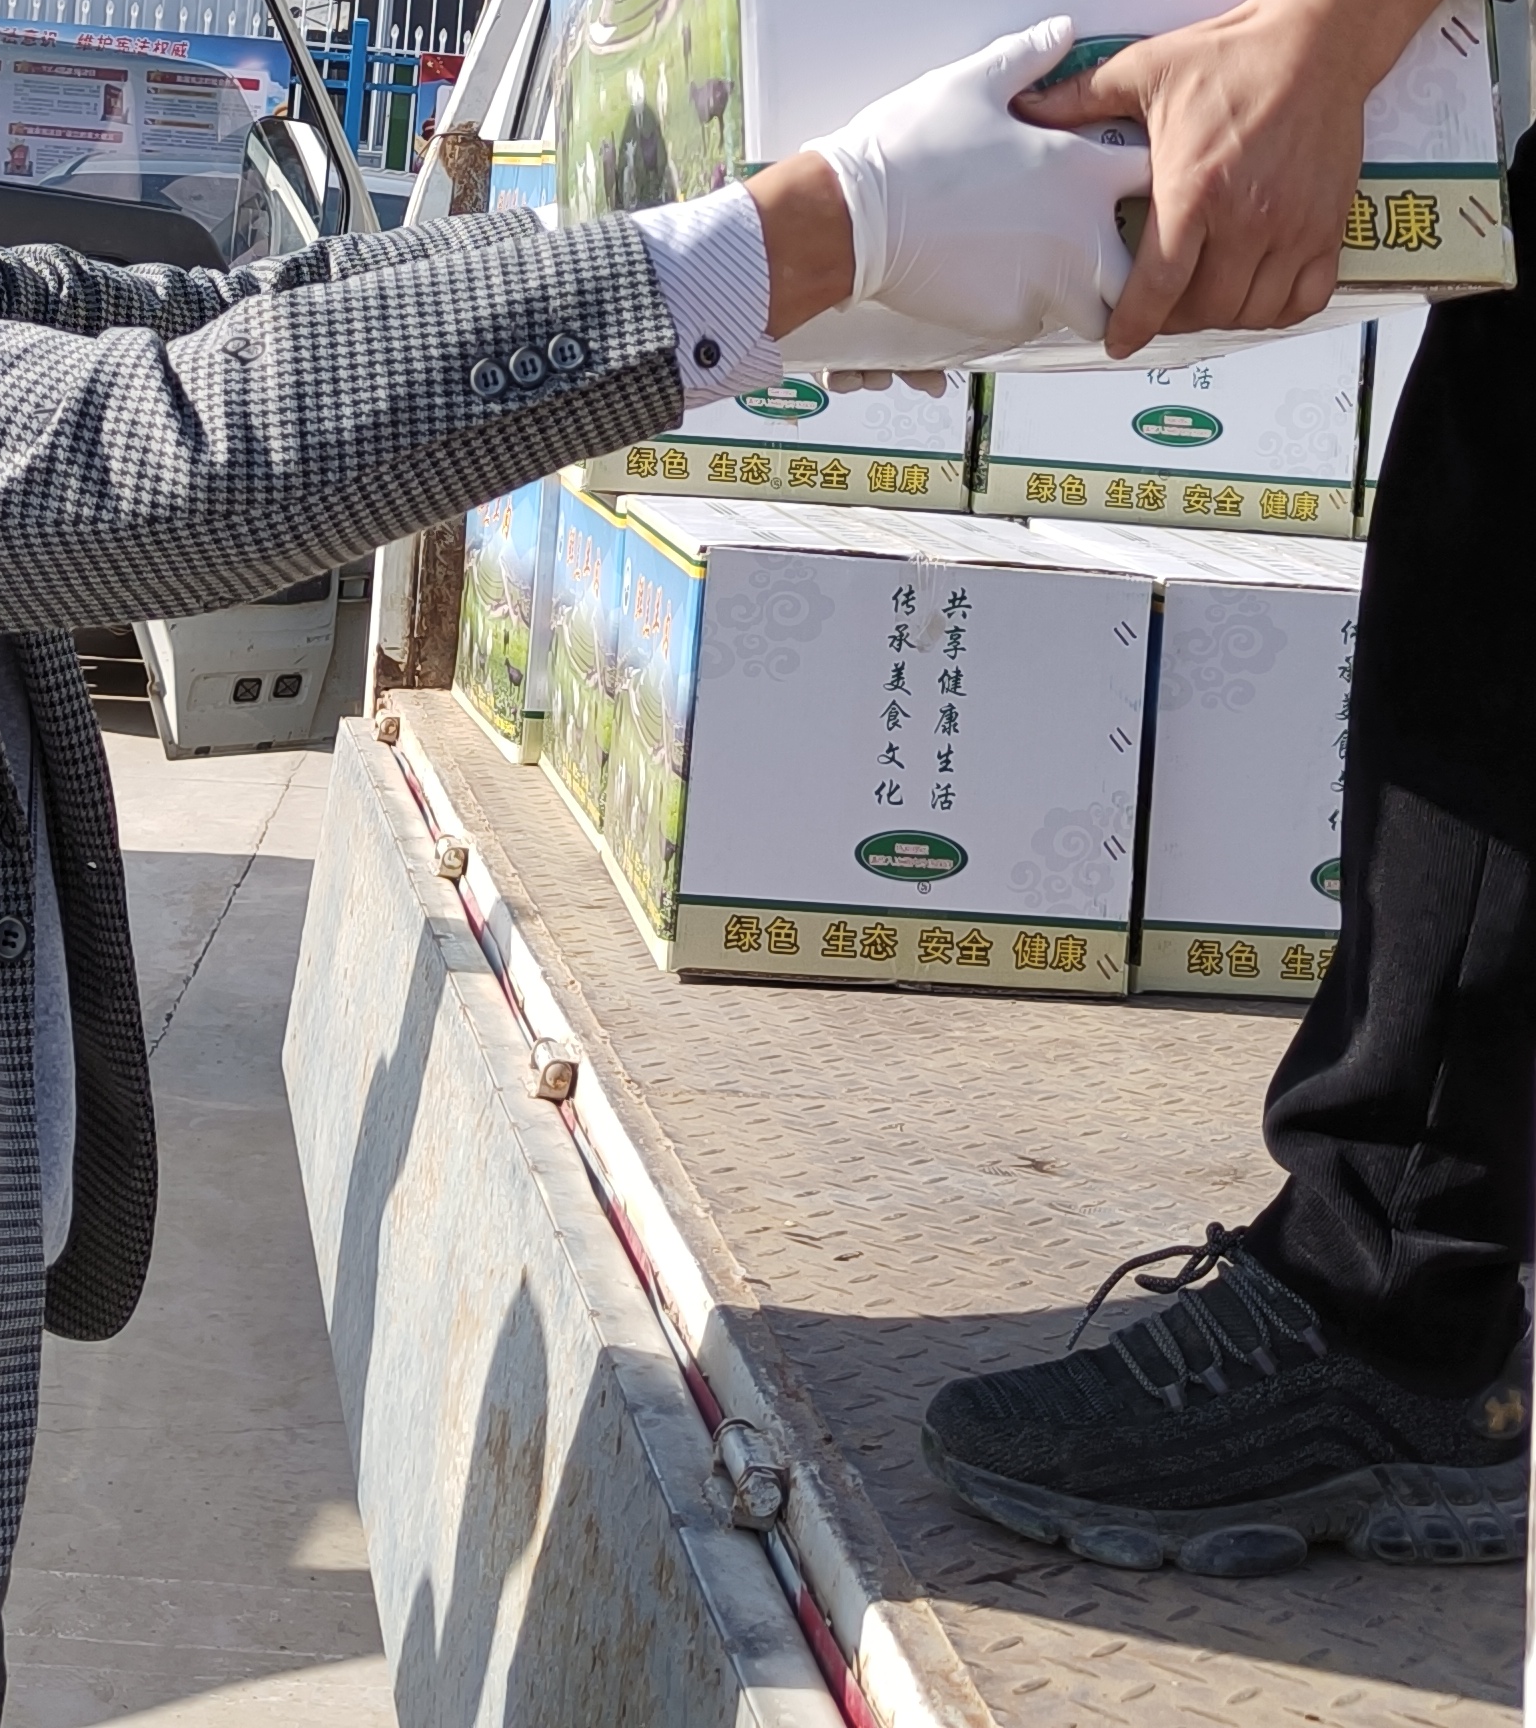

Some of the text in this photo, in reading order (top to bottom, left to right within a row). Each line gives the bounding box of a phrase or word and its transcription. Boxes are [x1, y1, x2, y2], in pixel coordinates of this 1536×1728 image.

[75, 32, 189, 60] 维护宪法权威
[627, 447, 929, 494] 绿色 生态 安全 健康
[1027, 474, 1318, 521] 绿色 生态 安全 健康
[875, 585, 916, 805] 传承美食文化
[932, 588, 972, 810] 共享健康生活
[724, 915, 1087, 972] 绿色 生态 安全 健康
[1188, 940, 1259, 977] 绿色
